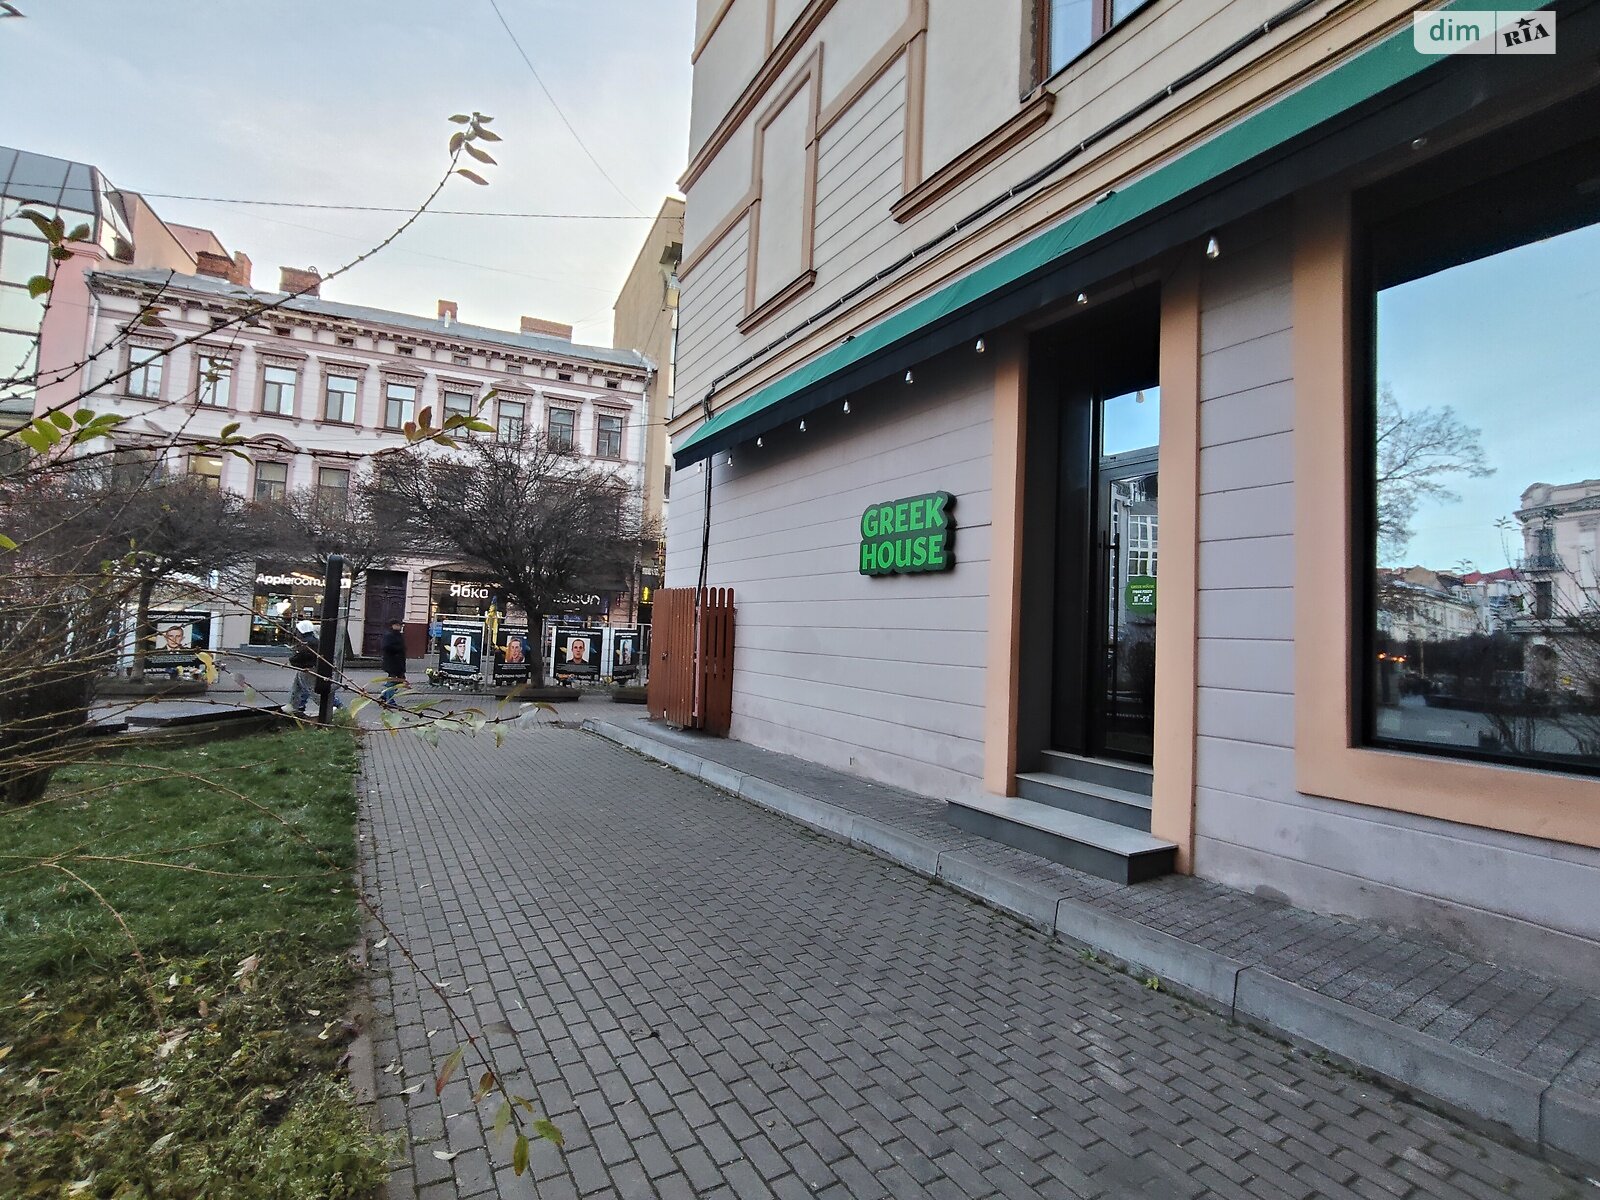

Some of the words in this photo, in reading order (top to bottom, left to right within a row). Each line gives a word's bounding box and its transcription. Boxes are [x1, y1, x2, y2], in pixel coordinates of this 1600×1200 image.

[863, 496, 944, 538] GREEK
[862, 534, 943, 570] HOUSE
[450, 584, 489, 599] Ябко
